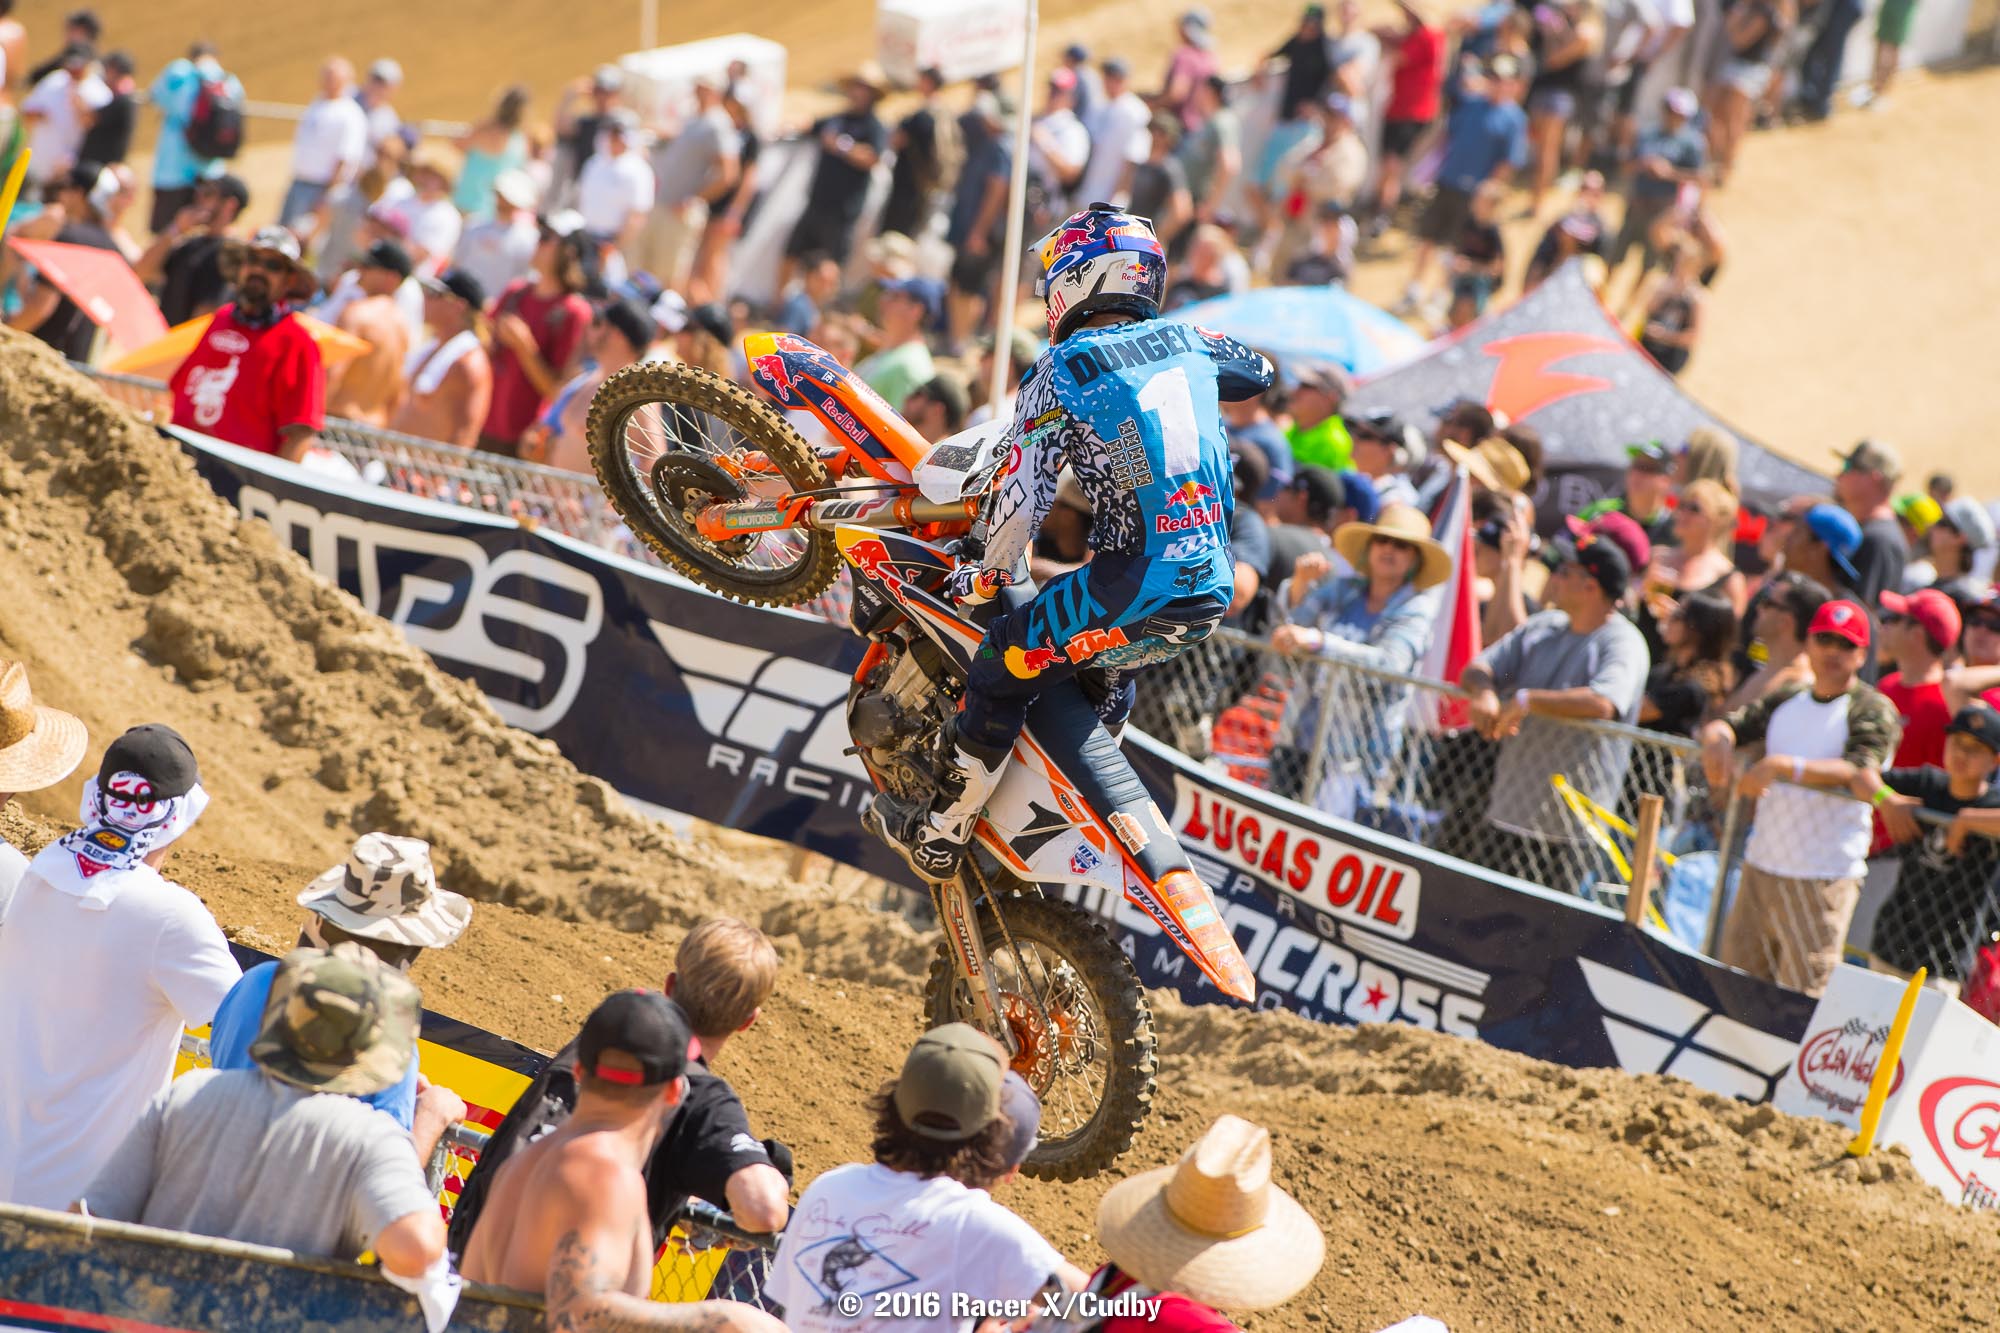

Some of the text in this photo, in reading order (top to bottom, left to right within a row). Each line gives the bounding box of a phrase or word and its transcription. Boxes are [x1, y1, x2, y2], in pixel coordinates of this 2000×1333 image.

[1065, 323, 1193, 388] DUNGEY
[1136, 366, 1200, 479] 1
[738, 513, 777, 526] MOTOREX
[1156, 502, 1222, 534] Red Bull
[642, 532, 702, 576] DUNLOP
[857, 585, 882, 607] KTM
[1027, 563, 1108, 647] FOX
[1064, 626, 1131, 664] KTM
[706, 743, 874, 814] RACI
[1182, 790, 1405, 926] LUCAS OIL
[1128, 885, 1191, 945] DUNLOP
[1062, 880, 1485, 1040] OOCROSS
